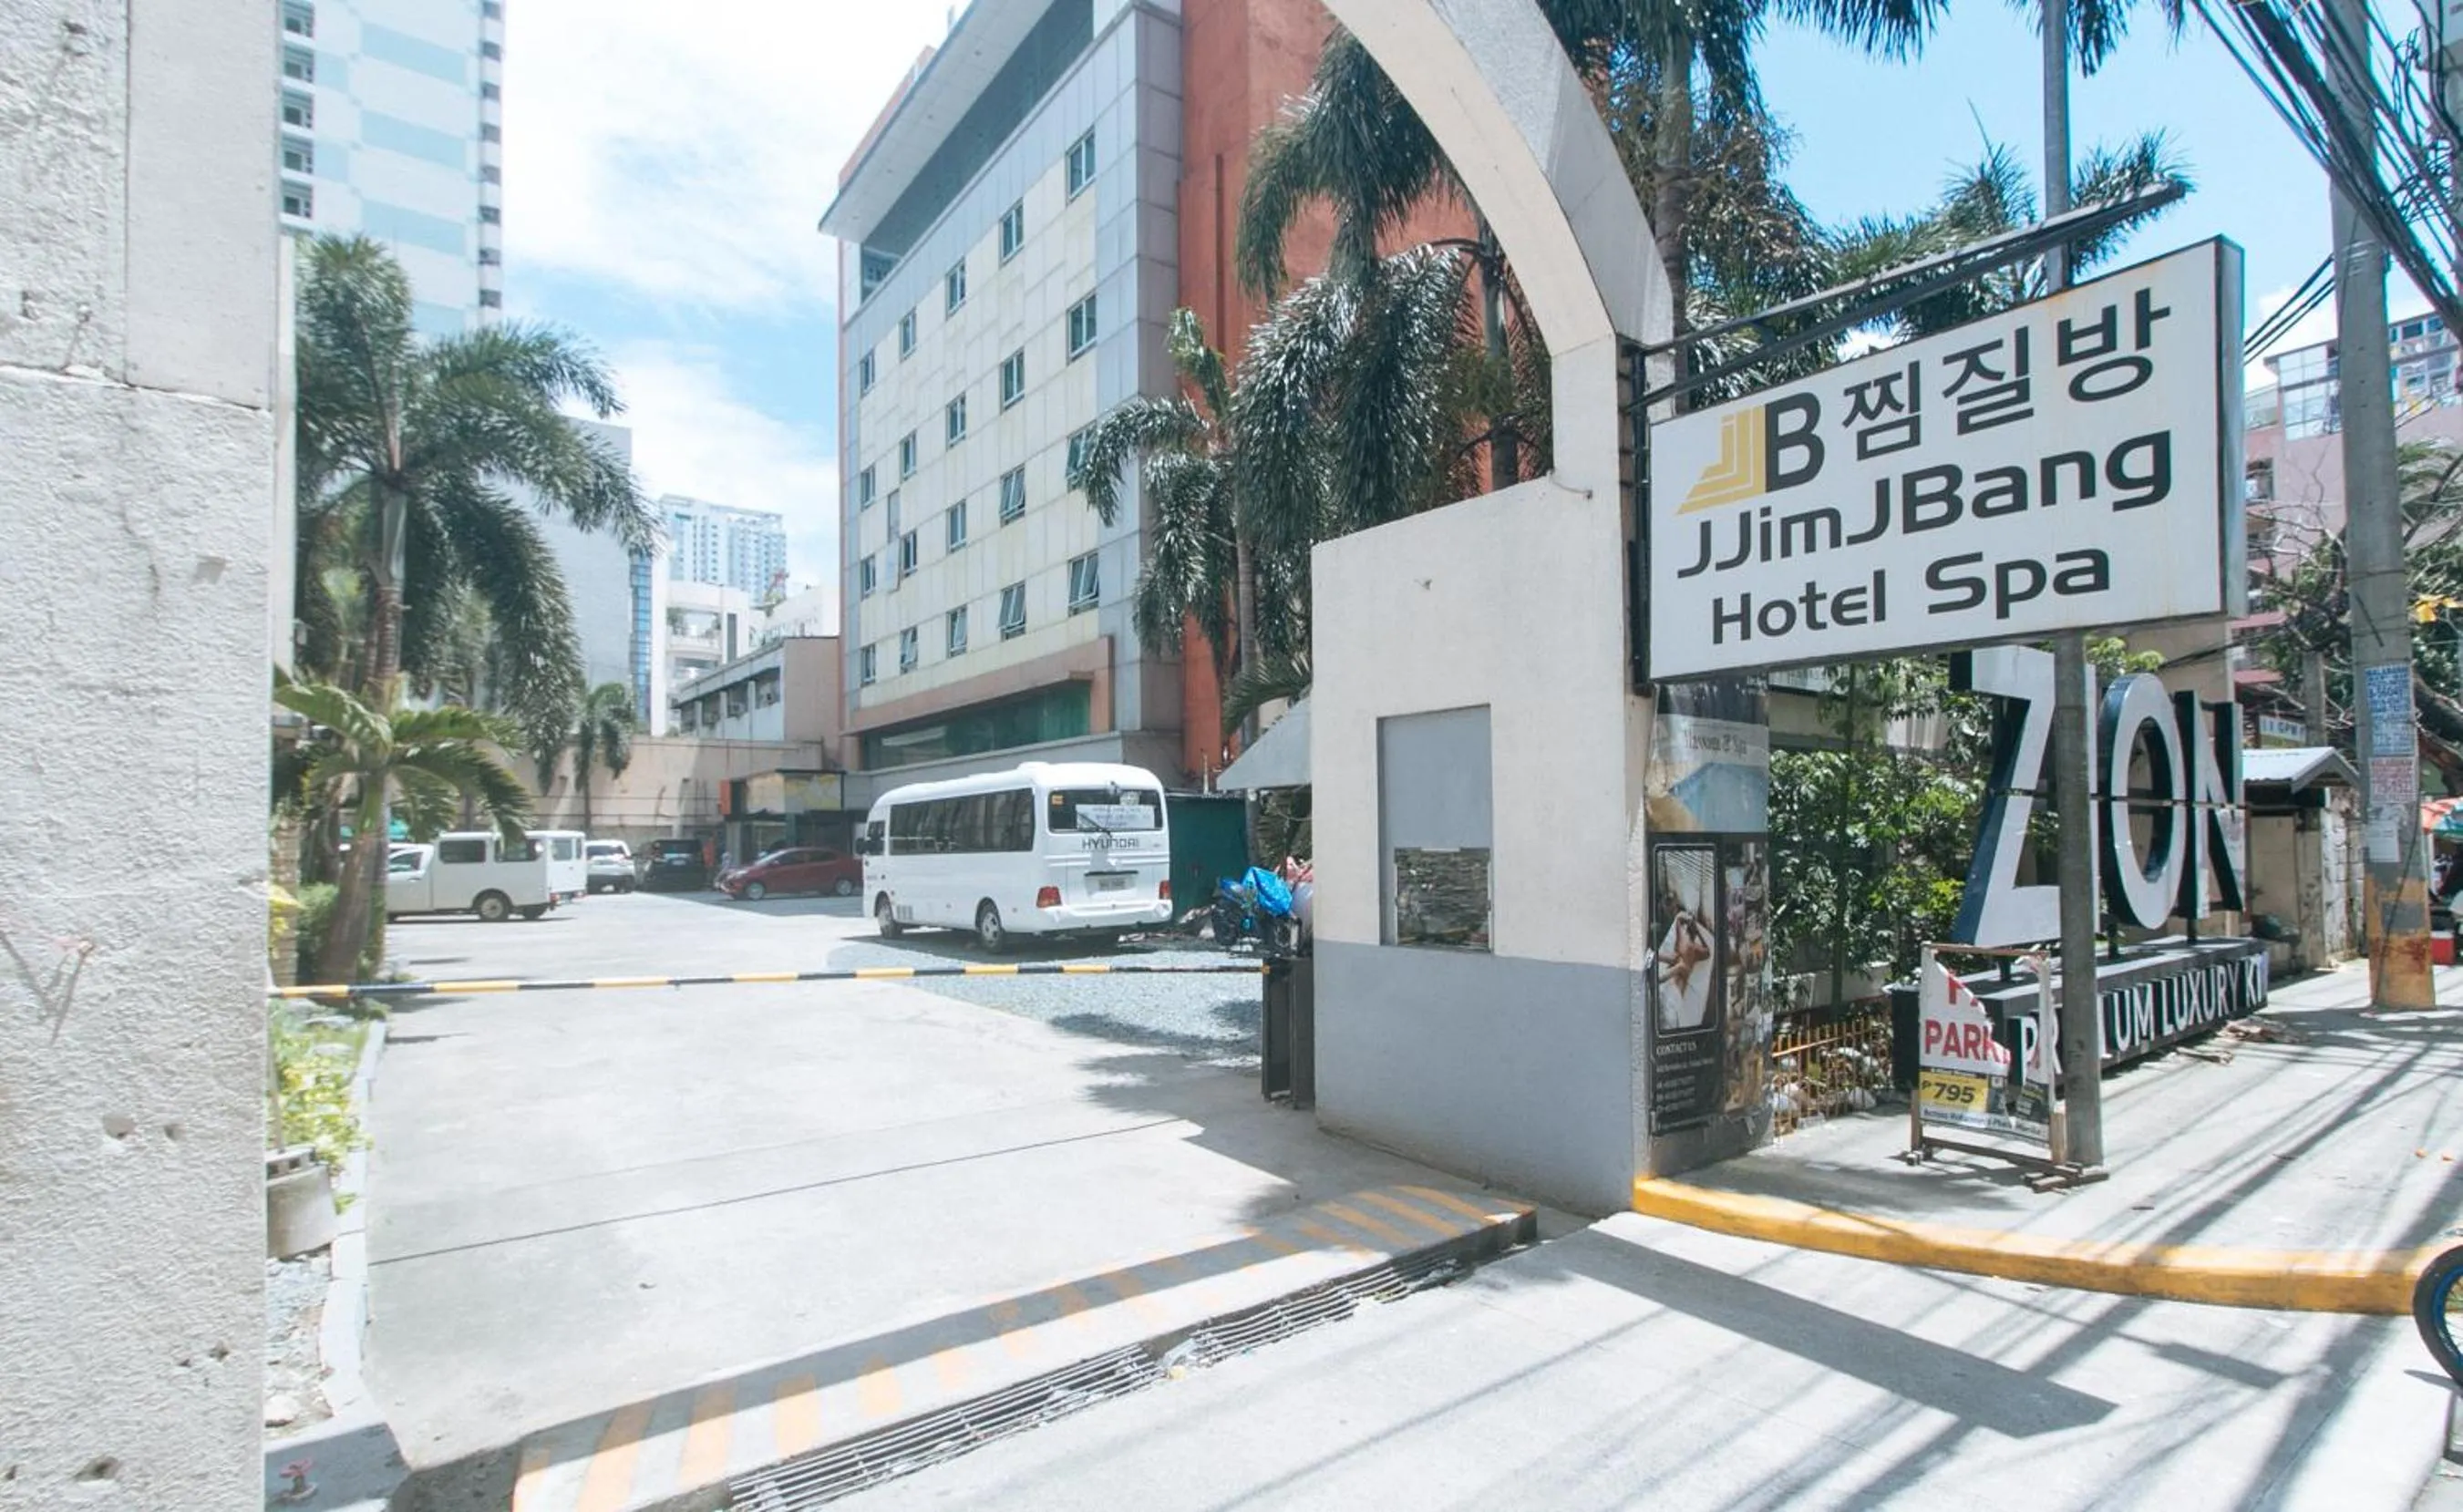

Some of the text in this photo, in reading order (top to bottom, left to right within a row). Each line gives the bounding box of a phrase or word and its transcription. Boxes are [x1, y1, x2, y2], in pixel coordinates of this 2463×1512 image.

[1842, 288, 2170, 460] 찜질방
[1677, 430, 2171, 578] JJimJBang
[1712, 548, 2109, 644] Hotel Spa
[1082, 838, 1139, 850] HYUNDAI
[2160, 962, 2240, 1037] LUXURY
